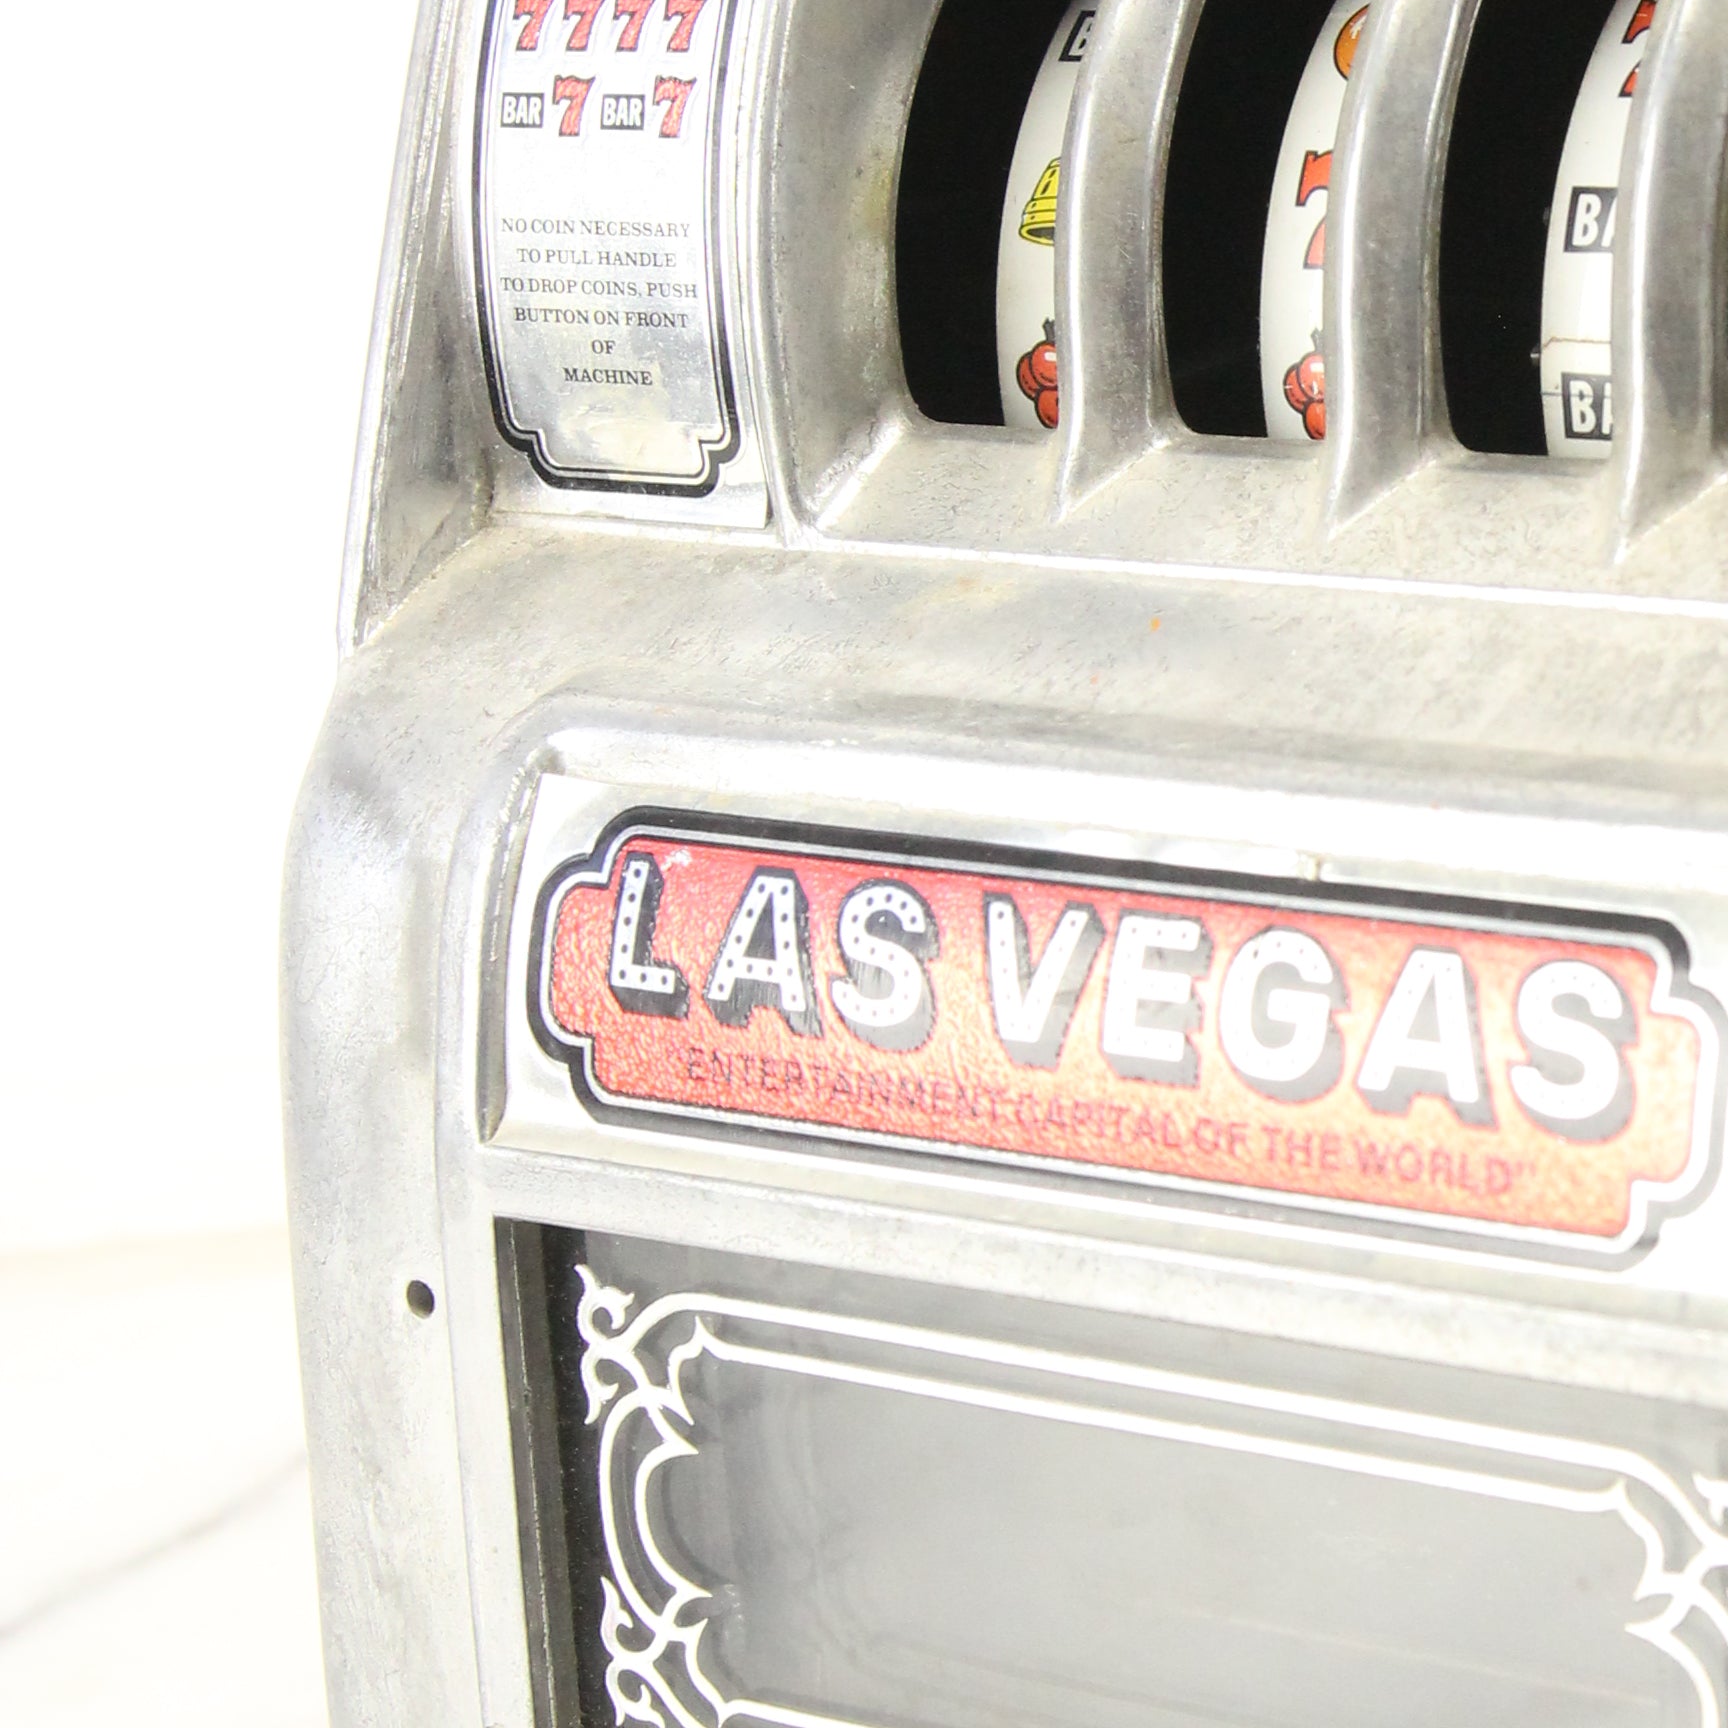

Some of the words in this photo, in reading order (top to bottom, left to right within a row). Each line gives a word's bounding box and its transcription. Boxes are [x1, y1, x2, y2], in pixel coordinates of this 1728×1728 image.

[502, 94, 542, 126] BAR
[552, 75, 596, 137] 7
[603, 96, 643, 127] BAR
[652, 75, 697, 138] 7
[501, 218, 527, 234] NO
[531, 219, 575, 235] COIN
[580, 220, 690, 238] NECESSARY
[516, 248, 541, 264] TO
[546, 249, 594, 266] PULL
[597, 251, 677, 268] HANDLE
[500, 277, 525, 292] TO
[528, 278, 577, 294] DROP
[581, 280, 642, 297] COINS,
[646, 282, 698, 299] PUSH
[514, 307, 589, 324] BUTTON
[593, 310, 620, 326] ON
[625, 312, 689, 328] FRONT
[591, 340, 616, 354] OF
[563, 367, 653, 386] MACHINE
[609, 852, 940, 1052] LAS
[982, 892, 1639, 1144] VEGAS
[1016, 1092, 1181, 1148] CAPITAL
[1194, 1117, 1250, 1157] OF
[1260, 1125, 1342, 1172] THE
